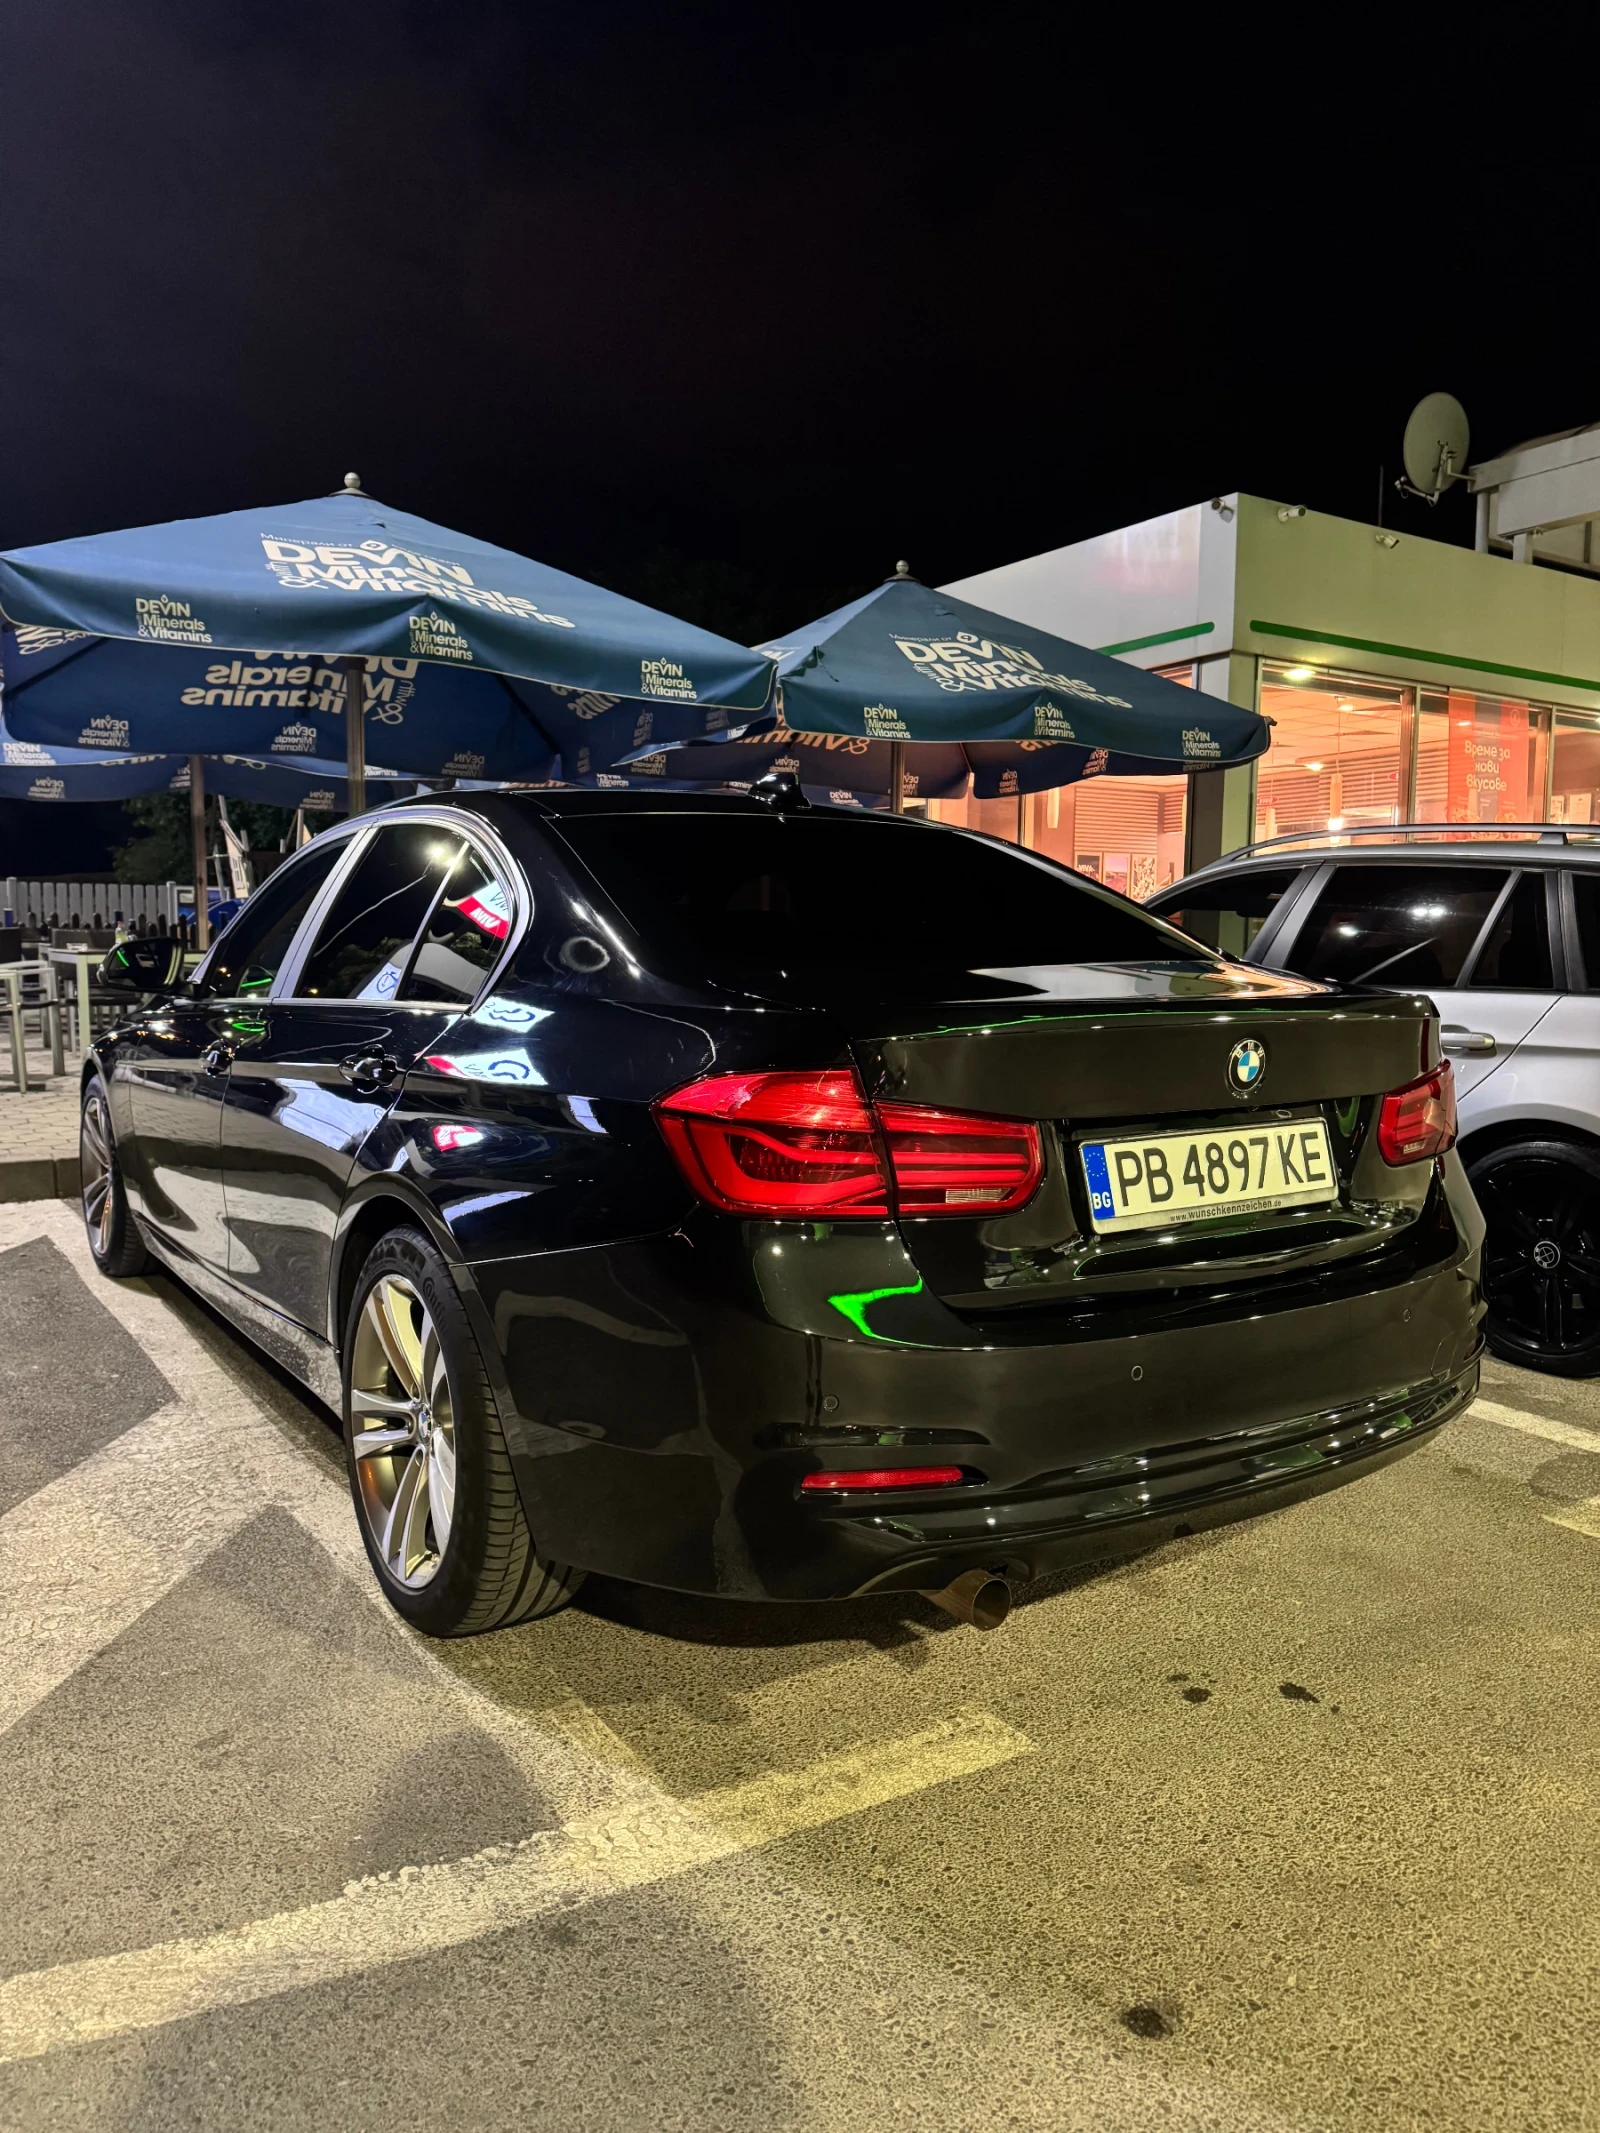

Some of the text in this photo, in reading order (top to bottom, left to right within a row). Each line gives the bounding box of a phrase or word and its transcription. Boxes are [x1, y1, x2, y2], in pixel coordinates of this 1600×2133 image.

[261, 539, 475, 586] DEVIN
[296, 563, 538, 611] Minerals
[136, 598, 191, 617] DEVIN
[143, 613, 206, 631] Minerals
[409, 615, 456, 634] DEVIN
[415, 630, 468, 649] Minerals
[895, 640, 1044, 671] DEVIN
[641, 660, 683, 677] DEVIN
[646, 673, 692, 689] Minerals
[863, 707, 898, 720] DEVIN
[1034, 706, 1063, 720] DEVIN
[868, 719, 906, 730] Minerals
[1036, 717, 1071, 729] Minerals
[1182, 730, 1210, 741] DEVIN
[3, 742, 41, 752] DEVIN
[1185, 740, 1220, 750] Minerals
[1465, 740, 1511, 761] Време за
[1475, 760, 1500, 774] нови
[828, 791, 853, 800] DEVIN
[1114, 1131, 1326, 1207] PB 4897 KE
[1092, 1192, 1112, 1210] BG
